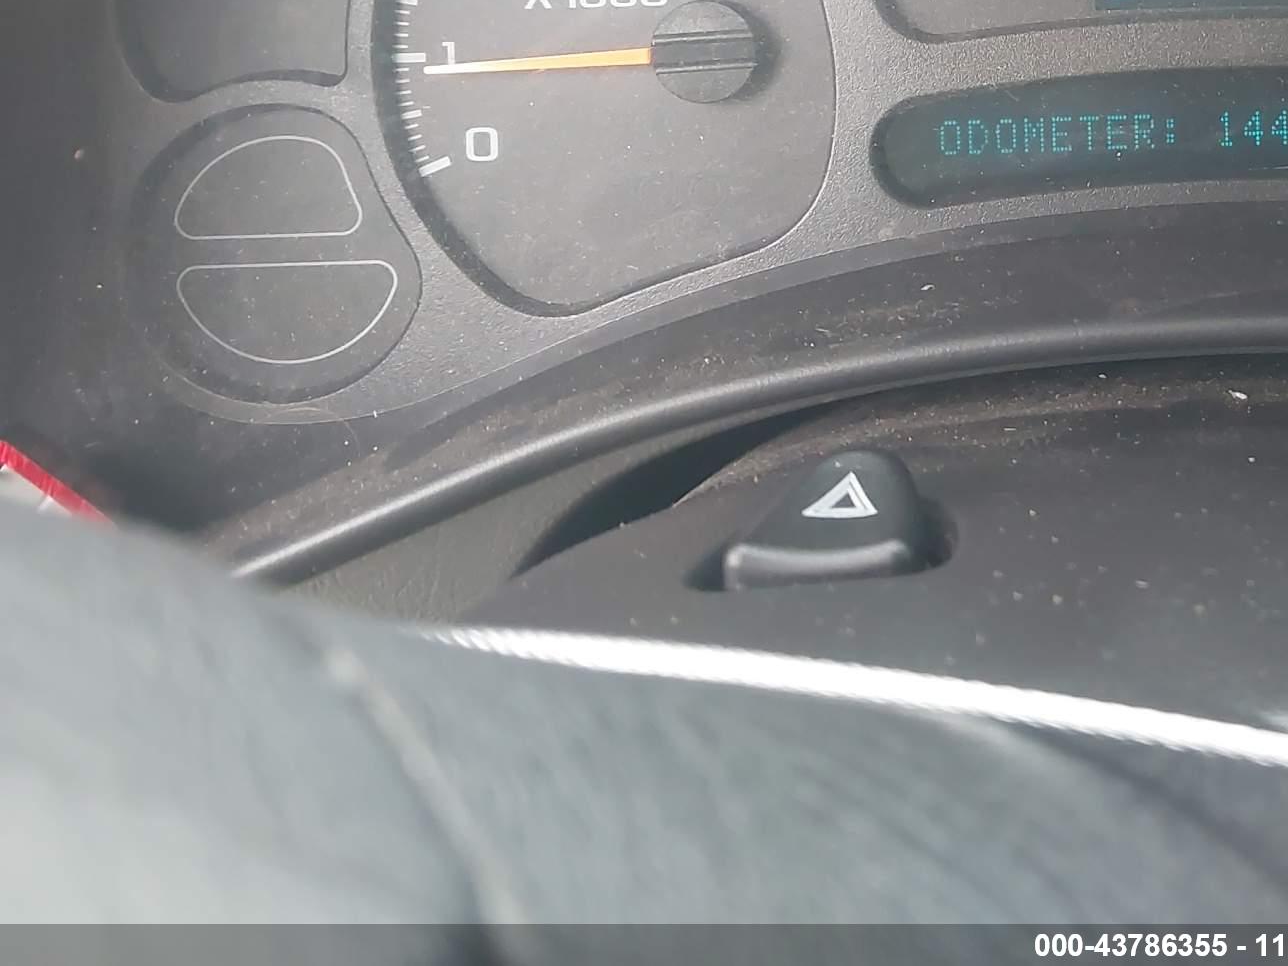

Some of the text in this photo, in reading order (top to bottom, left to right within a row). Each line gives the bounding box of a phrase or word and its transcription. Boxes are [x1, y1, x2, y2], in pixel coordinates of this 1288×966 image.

[441, 41, 456, 68] 1
[465, 127, 499, 162] 0
[940, 115, 1176, 155] ODOMETER:
